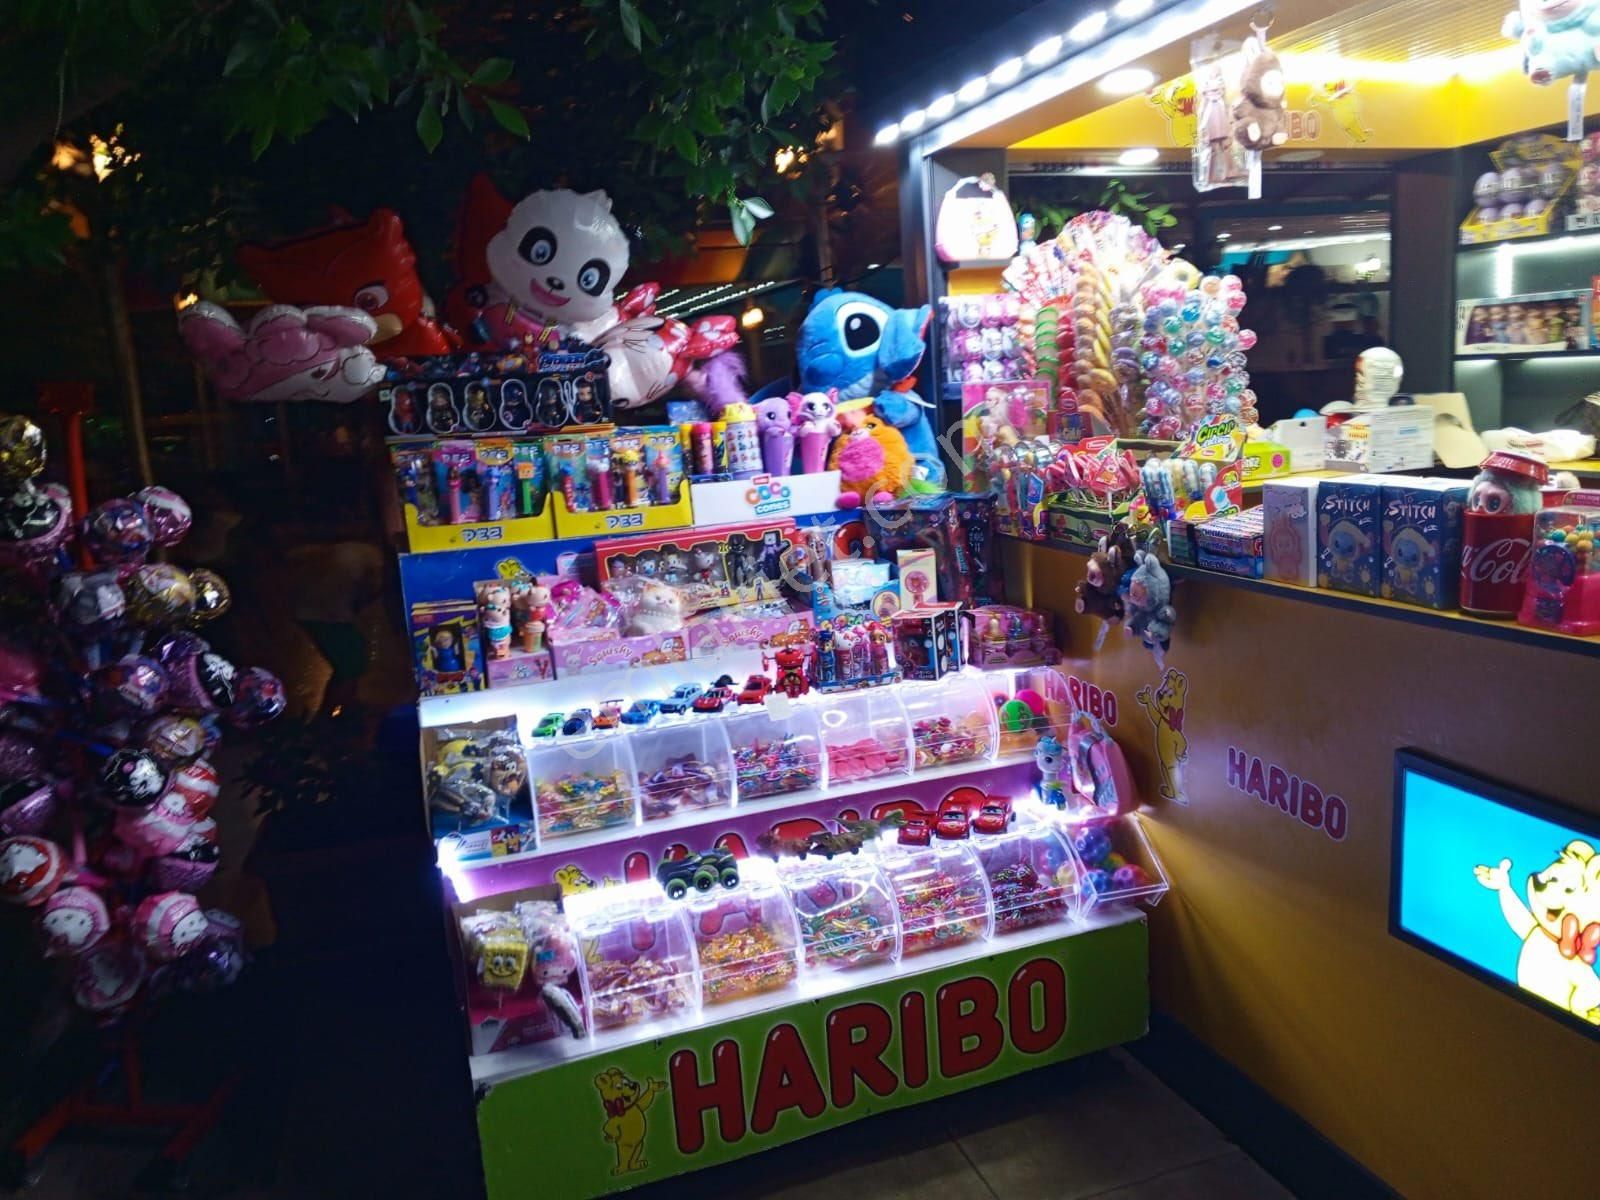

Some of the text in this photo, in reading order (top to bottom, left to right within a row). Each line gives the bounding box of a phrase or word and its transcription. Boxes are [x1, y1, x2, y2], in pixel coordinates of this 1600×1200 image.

[1325, 495, 1371, 512] STITCH
[1387, 500, 1436, 519] STITCH
[606, 512, 643, 529] PEZ
[461, 526, 503, 542] PEZ
[1226, 745, 1348, 842] HARIBO
[668, 957, 1068, 1154] HARIBO
